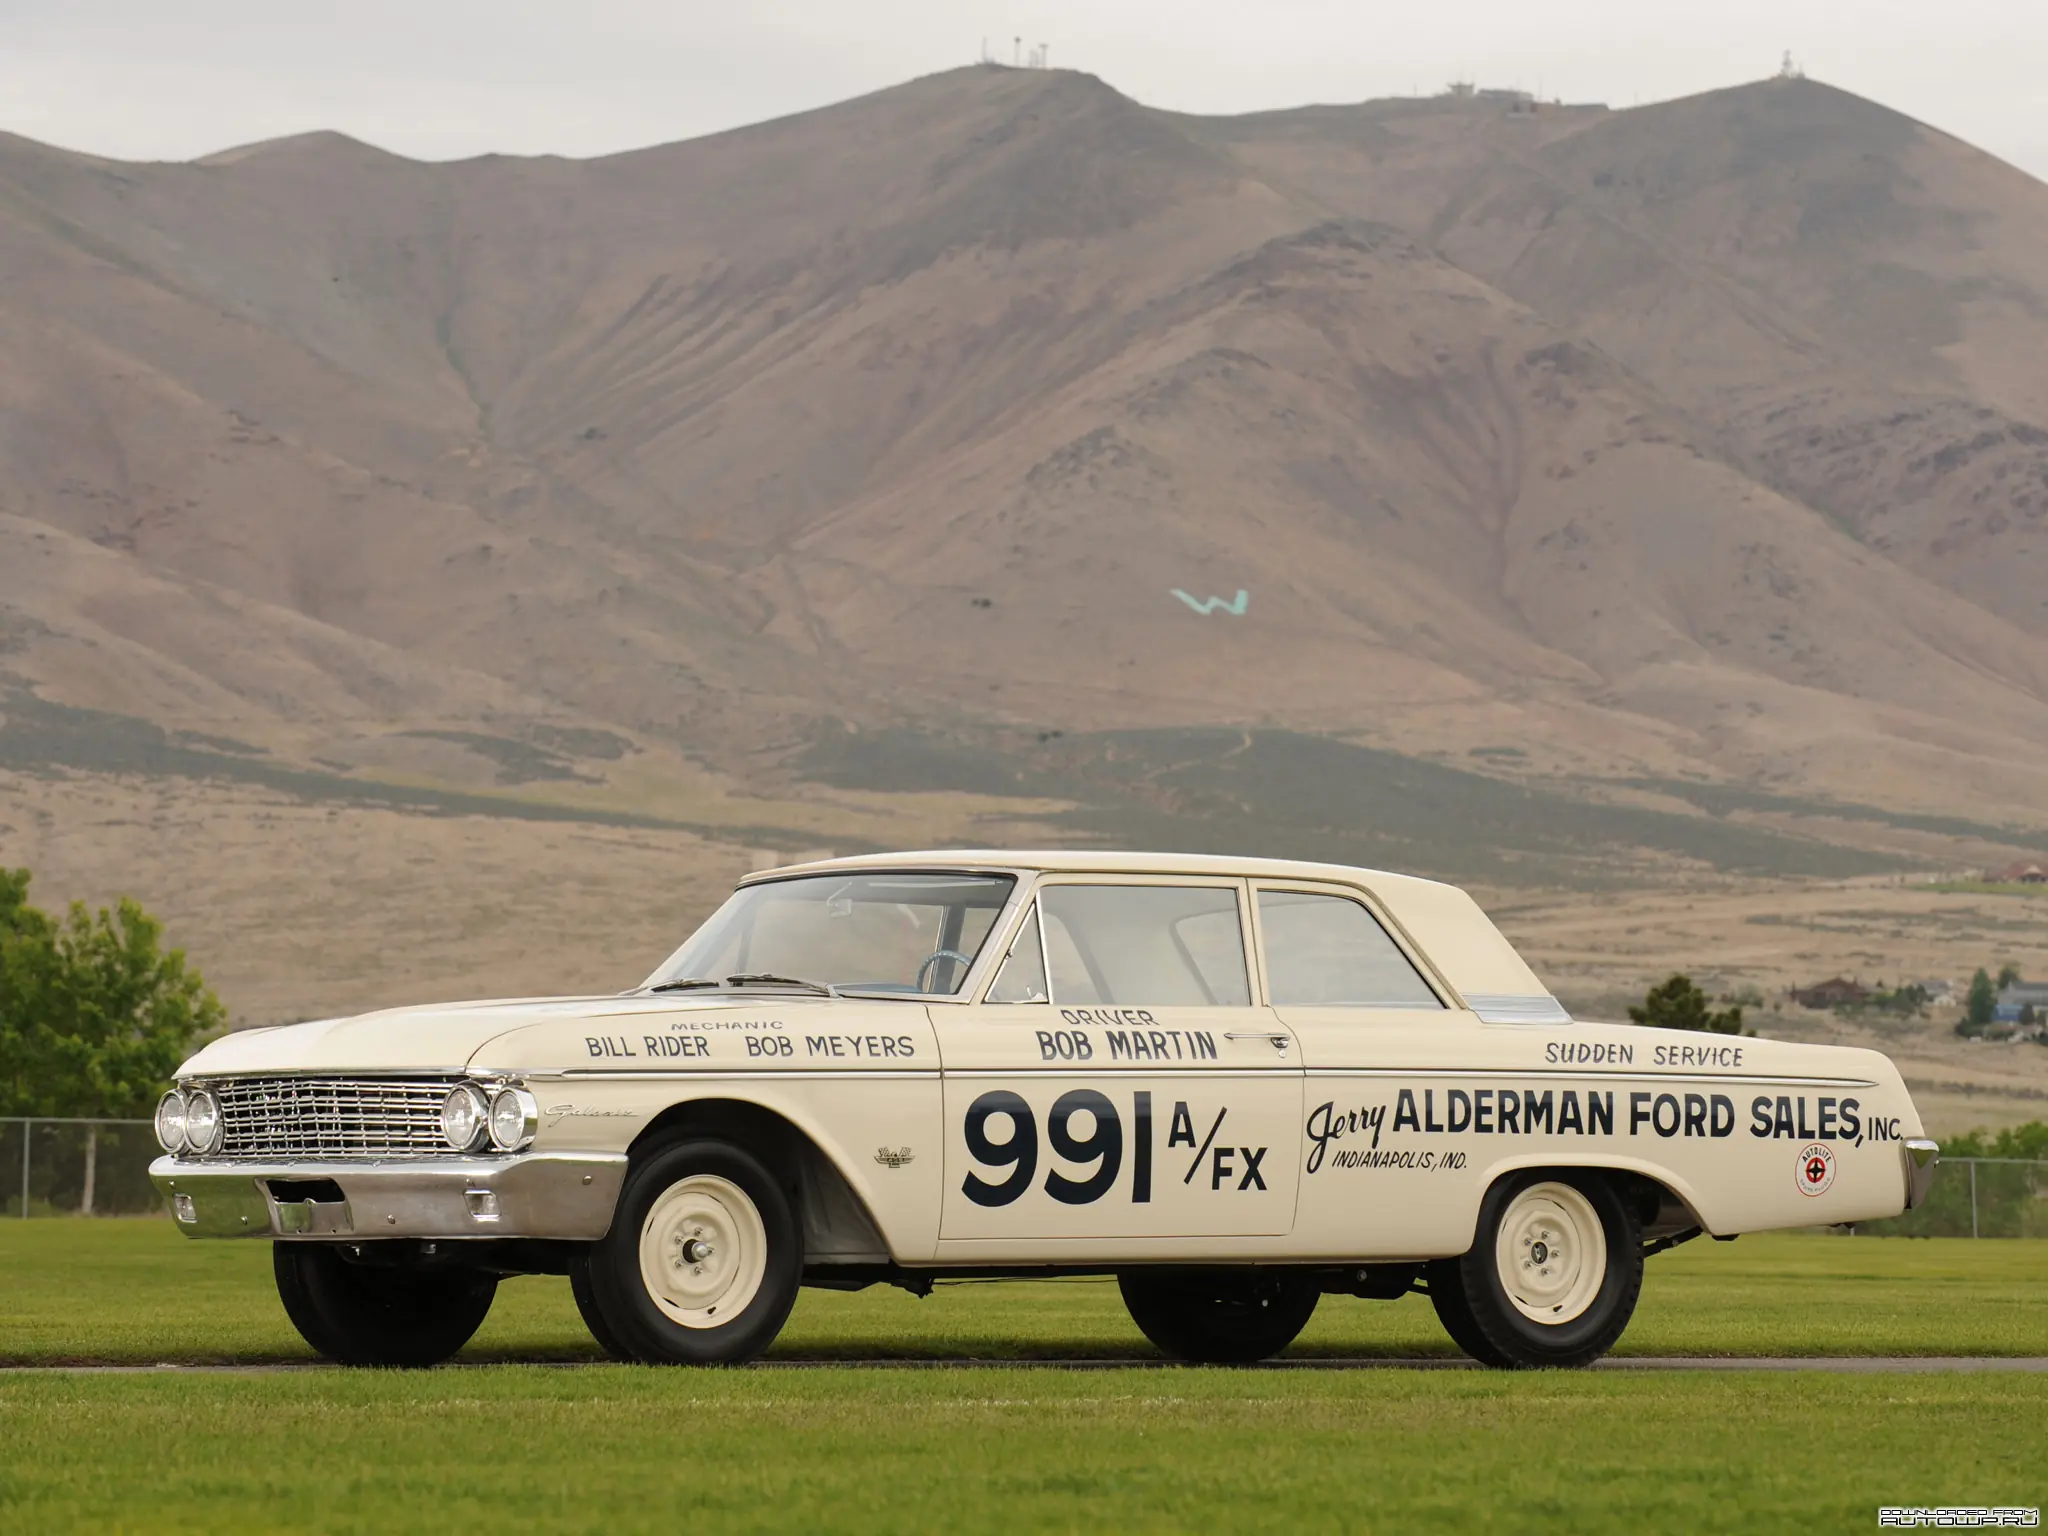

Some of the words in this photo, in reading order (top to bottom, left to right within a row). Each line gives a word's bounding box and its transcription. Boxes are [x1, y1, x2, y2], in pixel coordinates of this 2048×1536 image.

[671, 1020, 784, 1030] MECHANIC
[1060, 1009, 1160, 1026] DRIVER
[585, 1037, 636, 1057] BILL
[644, 1036, 710, 1057] RIDER
[745, 1036, 793, 1057] BOB
[806, 1036, 915, 1057] MEYERS
[1035, 1031, 1093, 1061] BOB
[1105, 1031, 1218, 1060] MARTIN
[1545, 1042, 1633, 1064] SUDDEN
[1653, 1045, 1743, 1067] SERVICE
[1306, 1101, 1387, 1174] Jerry
[1392, 1089, 1614, 1136] ALDERMAN
[1629, 1092, 1735, 1138] FORD
[1749, 1096, 1864, 1148] SALES,
[1868, 1117, 1904, 1141] INC.
[961, 1088, 1152, 1208] 991
[1802, 1146, 1832, 1163] AUTOLITE
